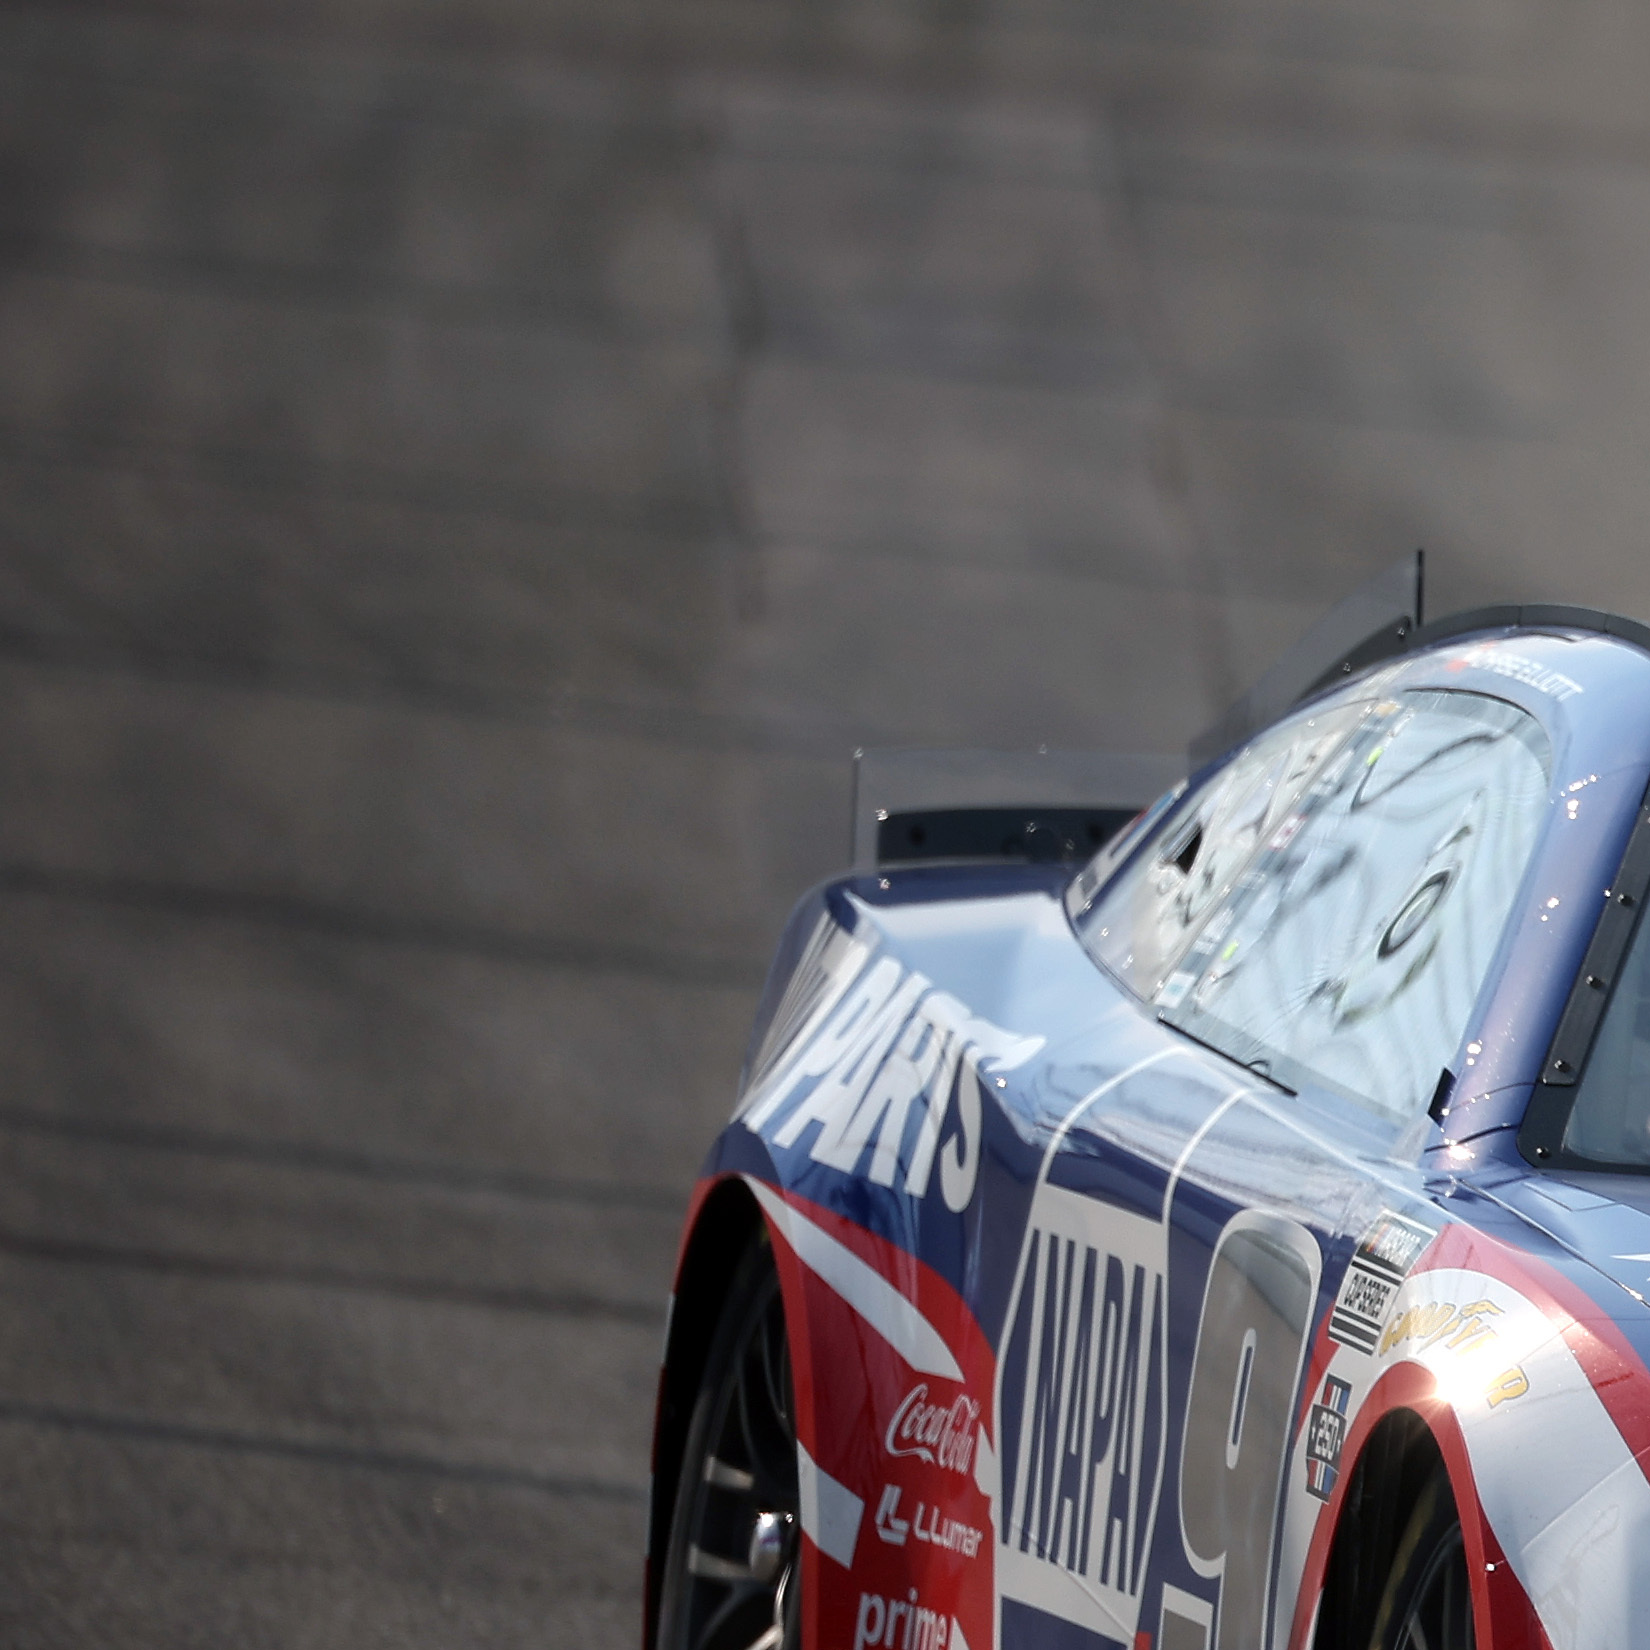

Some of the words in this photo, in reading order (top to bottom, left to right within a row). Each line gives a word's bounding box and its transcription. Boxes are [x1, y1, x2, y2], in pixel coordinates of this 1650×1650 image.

[747, 955, 1046, 1213] PARTS
[1018, 1232, 1147, 1596] NAPA
[1315, 1411, 1340, 1461] 250
